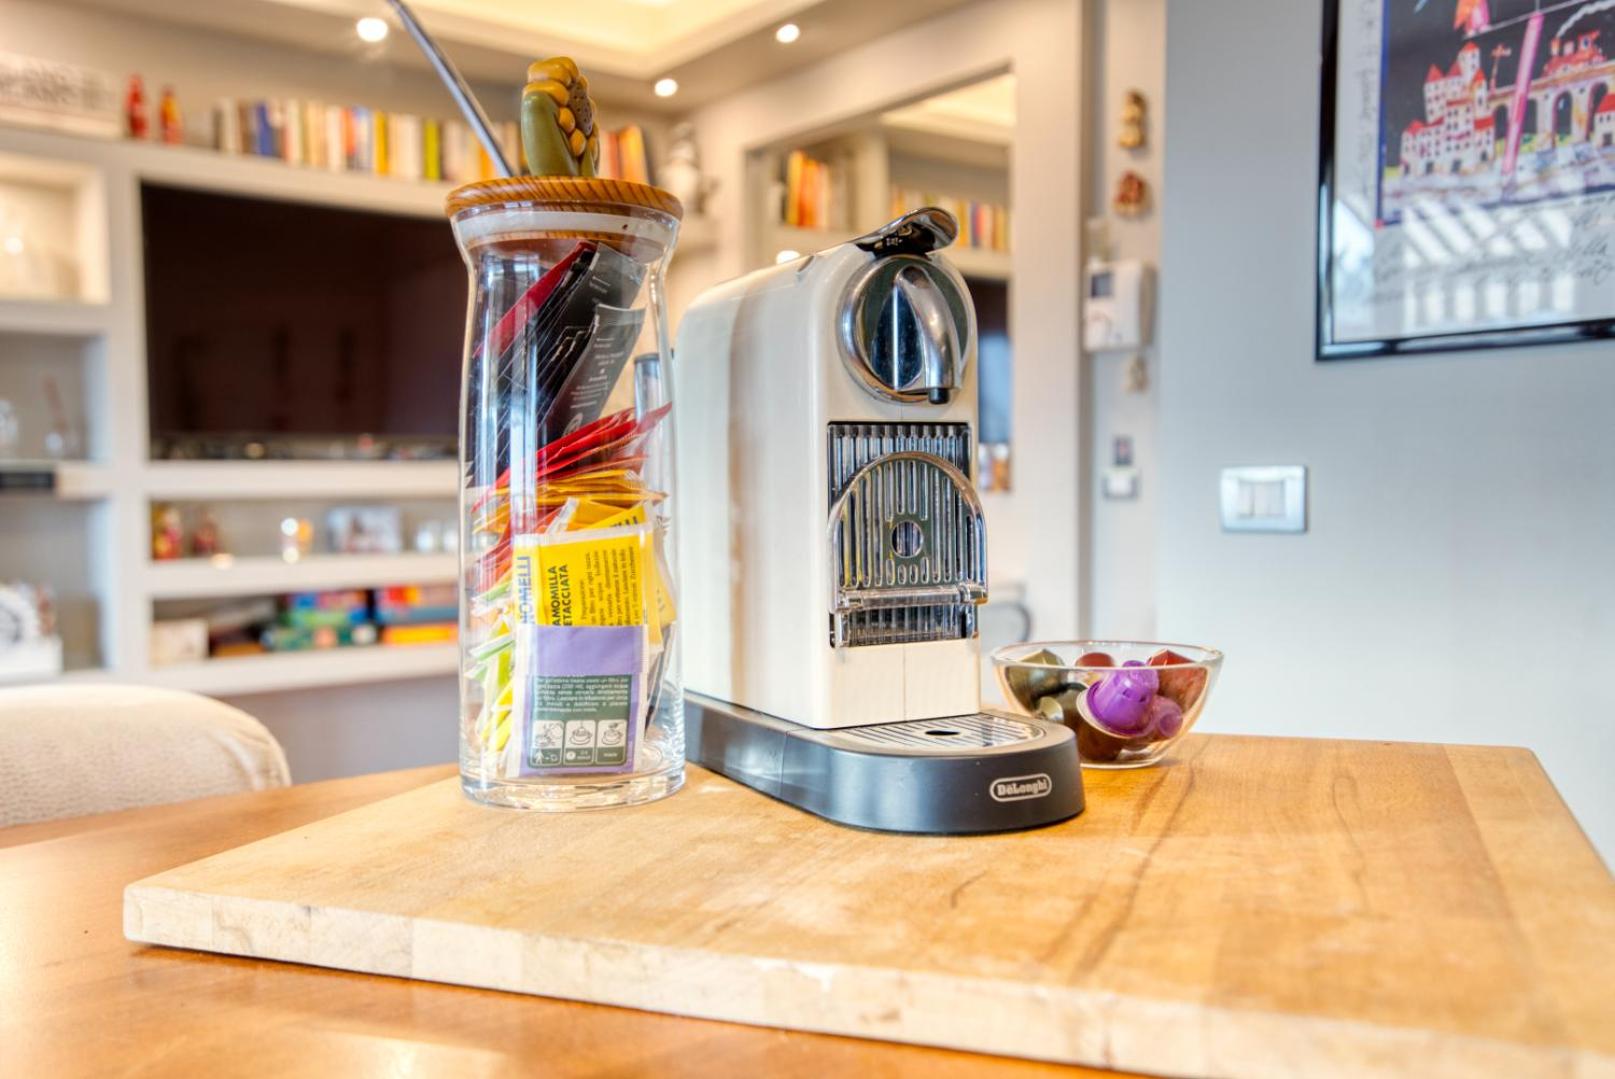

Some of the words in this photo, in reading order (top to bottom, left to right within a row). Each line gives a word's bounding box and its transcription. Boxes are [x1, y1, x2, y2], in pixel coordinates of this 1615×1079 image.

[518, 556, 534, 625] NOMELLI
[549, 566, 560, 626] AMOMILLA
[560, 565, 573, 626] ETACCIATA
